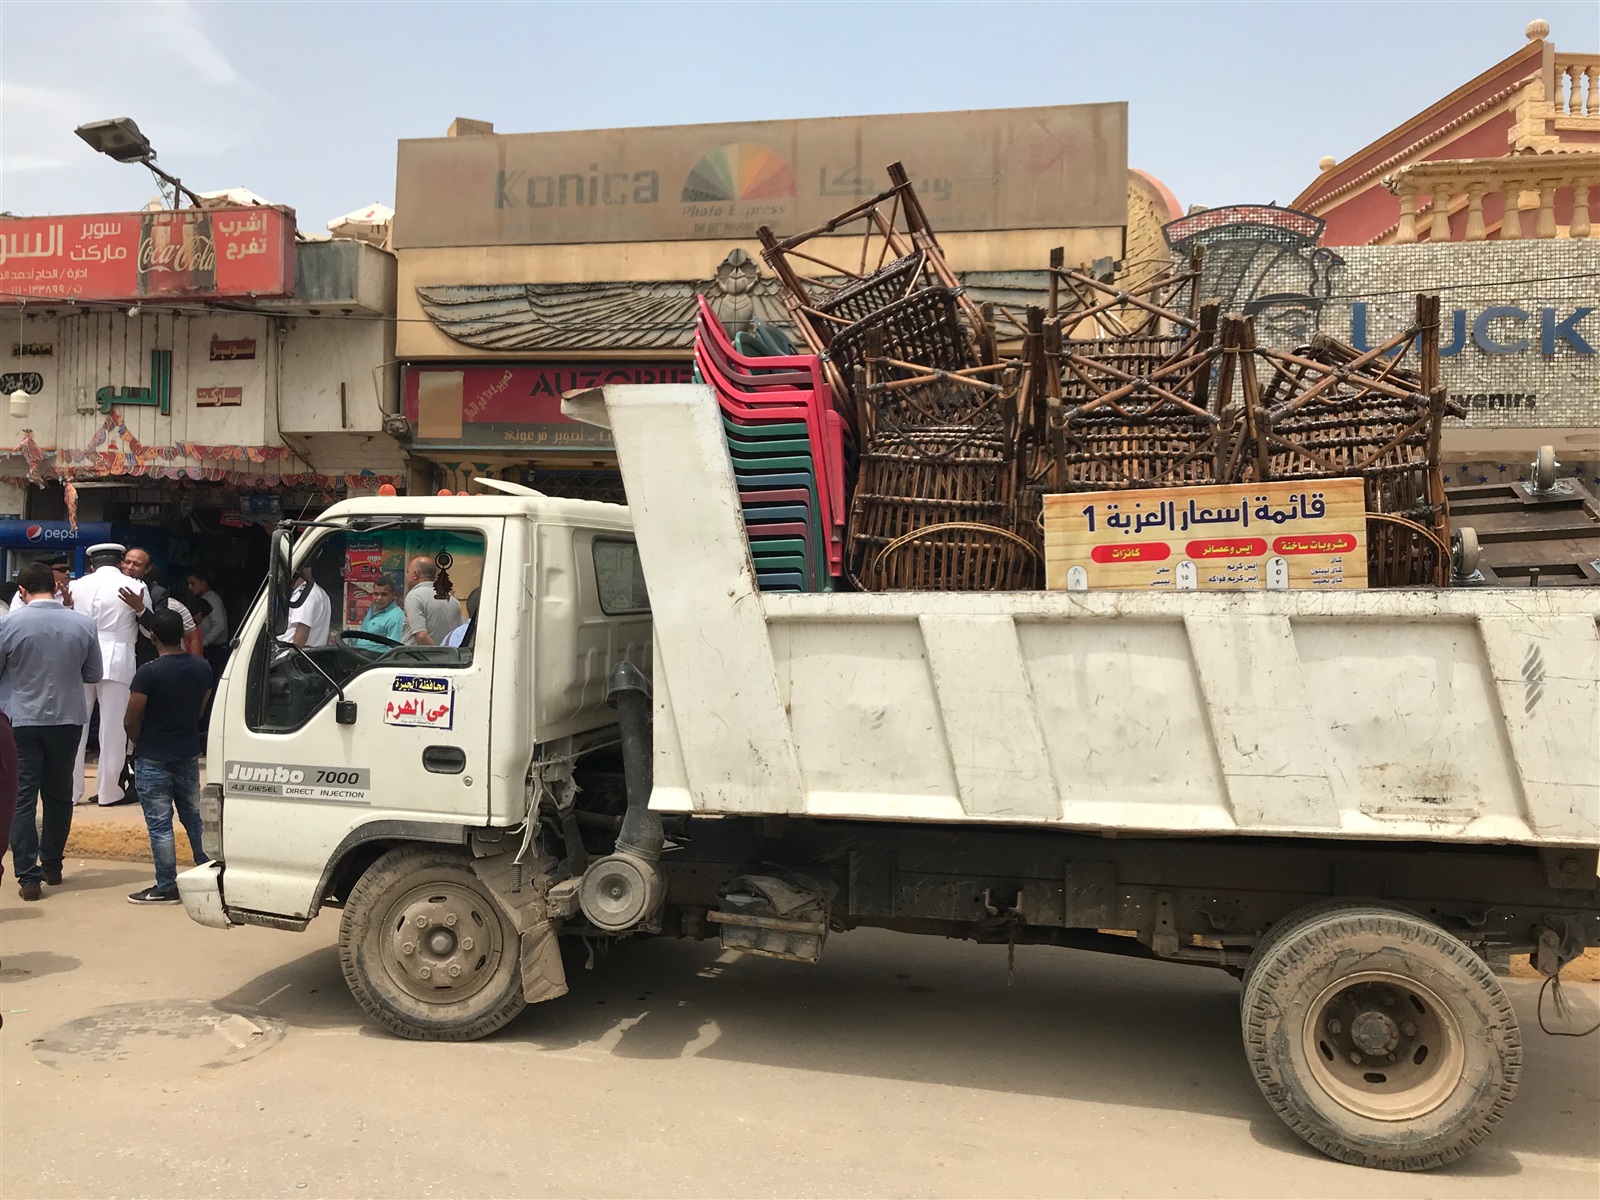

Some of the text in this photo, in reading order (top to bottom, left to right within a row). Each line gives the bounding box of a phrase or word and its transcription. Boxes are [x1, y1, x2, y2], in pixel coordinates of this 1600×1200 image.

[495, 163, 660, 209] Konica
[683, 203, 785, 219] Photo Epress
[80, 222, 121, 240] سوبر
[70, 243, 127, 263] ماركت
[137, 234, 216, 273] Coca-Cola
[1450, 394, 1537, 409] venirs
[1082, 493, 1326, 535] قائمة أسعار العزبة 1
[1281, 538, 1348, 551] مشروبات ساخنة
[1112, 547, 1141, 560] كانزات
[1226, 563, 1243, 571] كريم
[1227, 575, 1243, 583] كريم
[395, 678, 446, 691] محافظة الجيزة
[386, 697, 450, 722] حى الهرم
[228, 764, 360, 785] Jumbo 7000
[248, 784, 278, 793] DIESEL
[286, 787, 365, 799] DIRECT INJECTION
